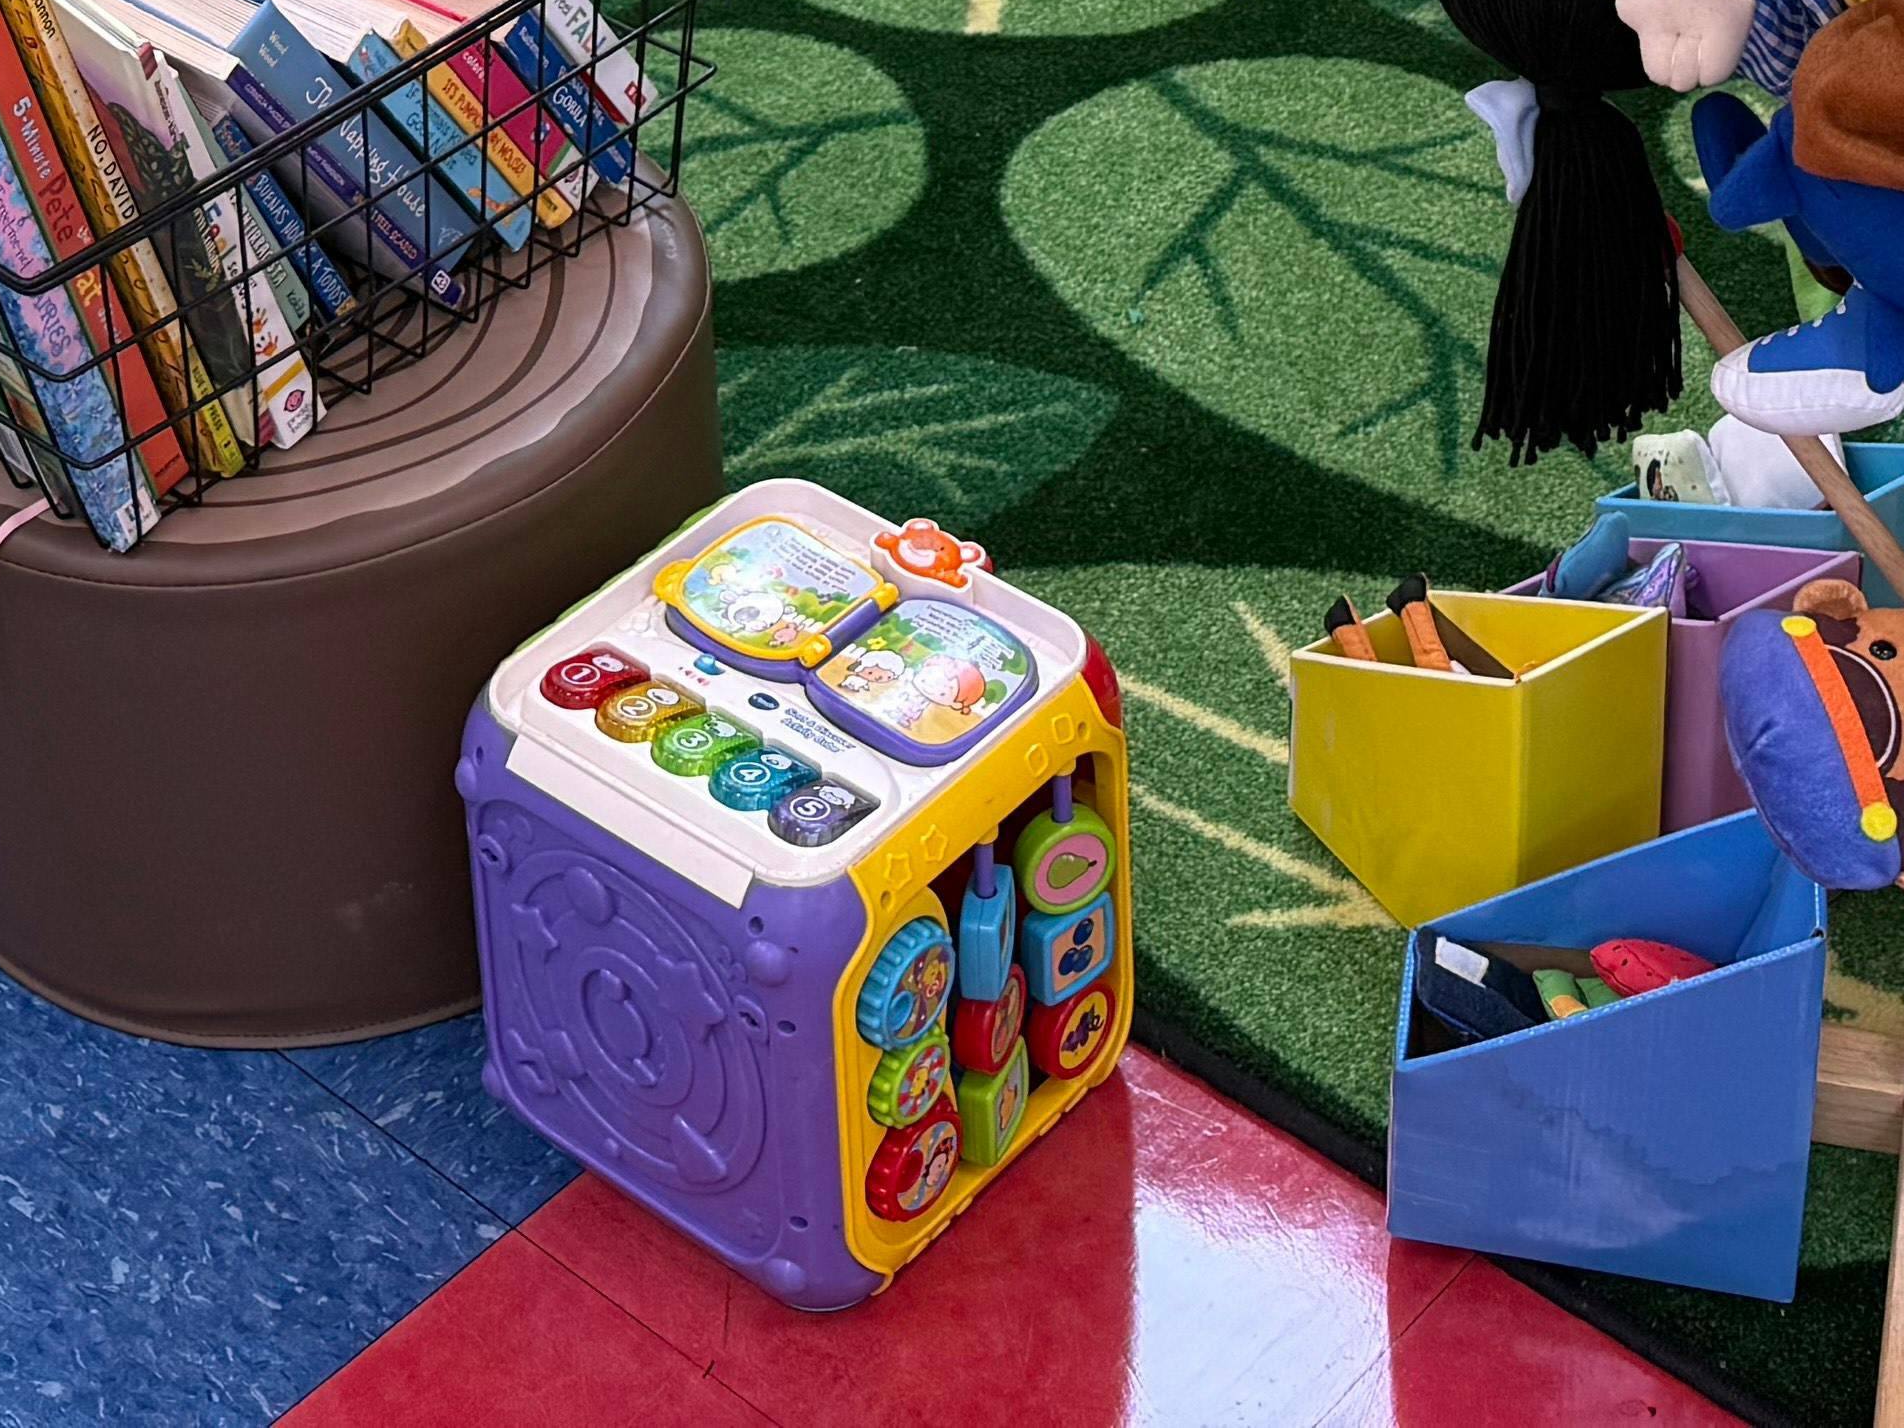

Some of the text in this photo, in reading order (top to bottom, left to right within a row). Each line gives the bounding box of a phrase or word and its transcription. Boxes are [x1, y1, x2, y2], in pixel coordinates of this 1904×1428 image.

[269, 30, 289, 56] Wood
[258, 45, 279, 69] Wood
[552, 85, 587, 129] GORILA
[12, 96, 53, 179] 5-Minute
[38, 171, 75, 244] Pete
[103, 160, 136, 221] DAVID
[254, 173, 289, 225] BUENAS
[31, 292, 73, 358] AIRIES
[574, 665, 589, 683] 1
[628, 697, 648, 716] 2
[685, 731, 703, 749] 3
[741, 766, 760, 782] 4
[799, 798, 822, 817] 5
